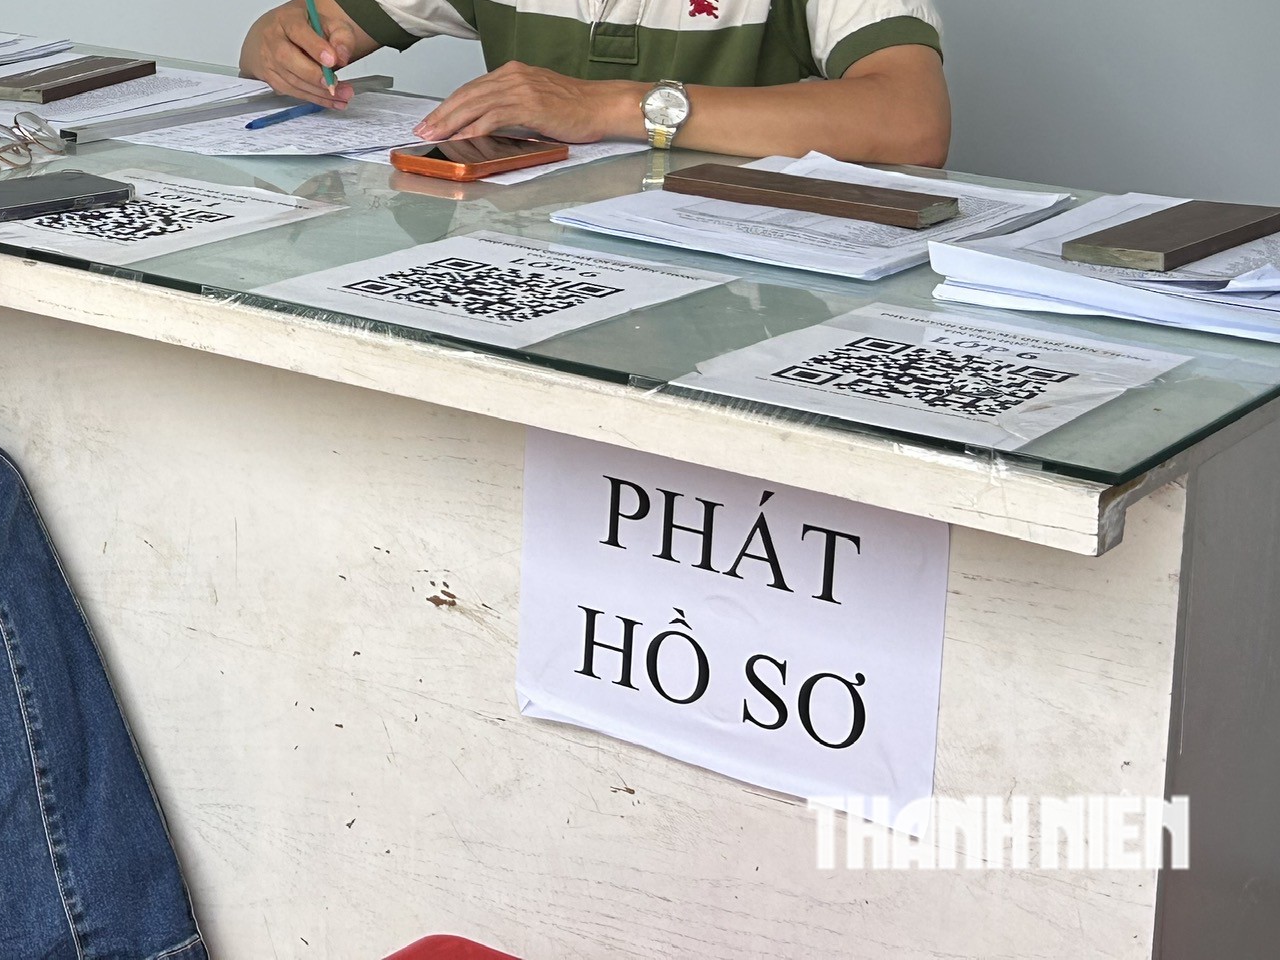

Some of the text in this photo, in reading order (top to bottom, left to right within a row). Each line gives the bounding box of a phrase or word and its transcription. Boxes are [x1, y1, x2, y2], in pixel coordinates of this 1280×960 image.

[509, 259, 576, 271] LỚP
[930, 337, 1009, 352] LỚP
[599, 474, 861, 605] PHÁT
[573, 605, 867, 749] HỒ SƠ
